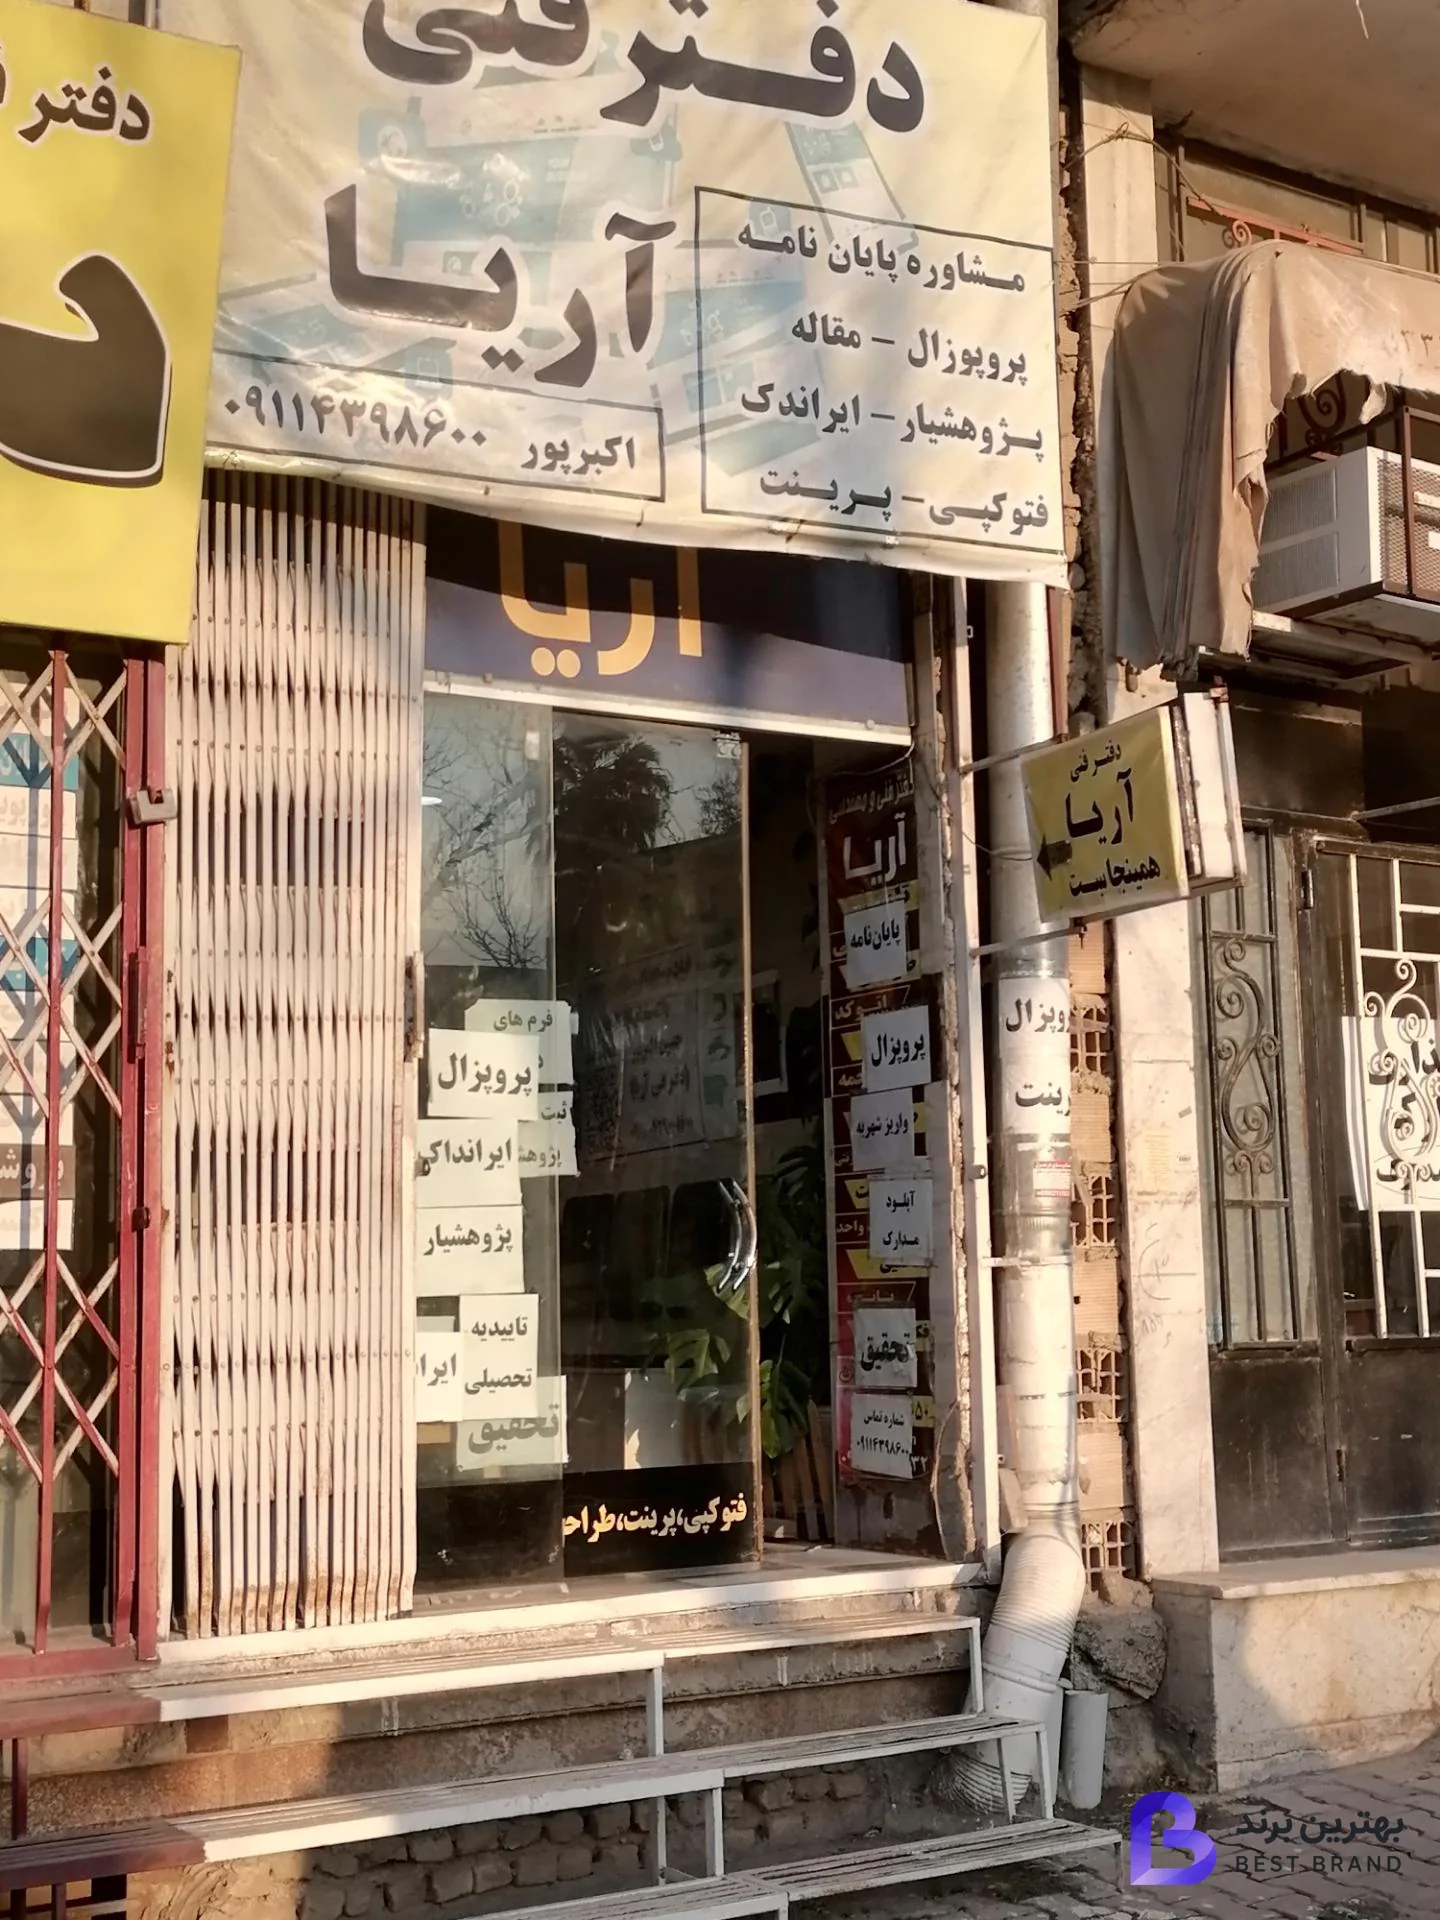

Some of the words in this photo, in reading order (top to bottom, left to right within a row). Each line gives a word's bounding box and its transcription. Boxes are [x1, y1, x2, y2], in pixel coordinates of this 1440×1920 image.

[600, 0, 925, 132] دفتر
[17, 66, 150, 143] دفتر
[737, 223, 818, 259] نامه
[828, 233, 899, 284] پایان
[324, 183, 677, 388] آریا
[906, 250, 1026, 293] مشاوره
[791, 310, 862, 350] مقاله
[907, 327, 1028, 387] پروپوزال
[224, 385, 488, 448] ۰۹۱۱۴۳۹۸۶۰۰
[741, 382, 860, 434] ایراندک
[900, 402, 1043, 463] پژوهشیار
[759, 469, 892, 522] پرینت
[929, 493, 1049, 536] فتوکپی
[1070, 748, 1089, 783] فنی
[1091, 738, 1122, 777] دفتر
[1065, 767, 1134, 845] آریا
[843, 811, 907, 886] آریا
[850, 924, 872, 949] نامه
[872, 917, 900, 951] پایان
[493, 1010, 523, 1032] های
[527, 1009, 553, 1033] فرم
[1005, 997, 1070, 1033] وپزال
[871, 1033, 926, 1067] پروپزال
[438, 1051, 532, 1096] پروپزال
[540, 1100, 567, 1125] ثبت
[856, 1116, 881, 1139] شهریه
[884, 1112, 909, 1137] واریز
[422, 1223, 514, 1256] پژوهشیار
[882, 1230, 920, 1251] مدارک
[471, 1316, 528, 1342] تاییدیه
[860, 1332, 911, 1372] تحقیق
[464, 1367, 533, 1396] تحصیلی
[863, 1409, 883, 1425] تماس
[884, 1411, 905, 1429] شماره
